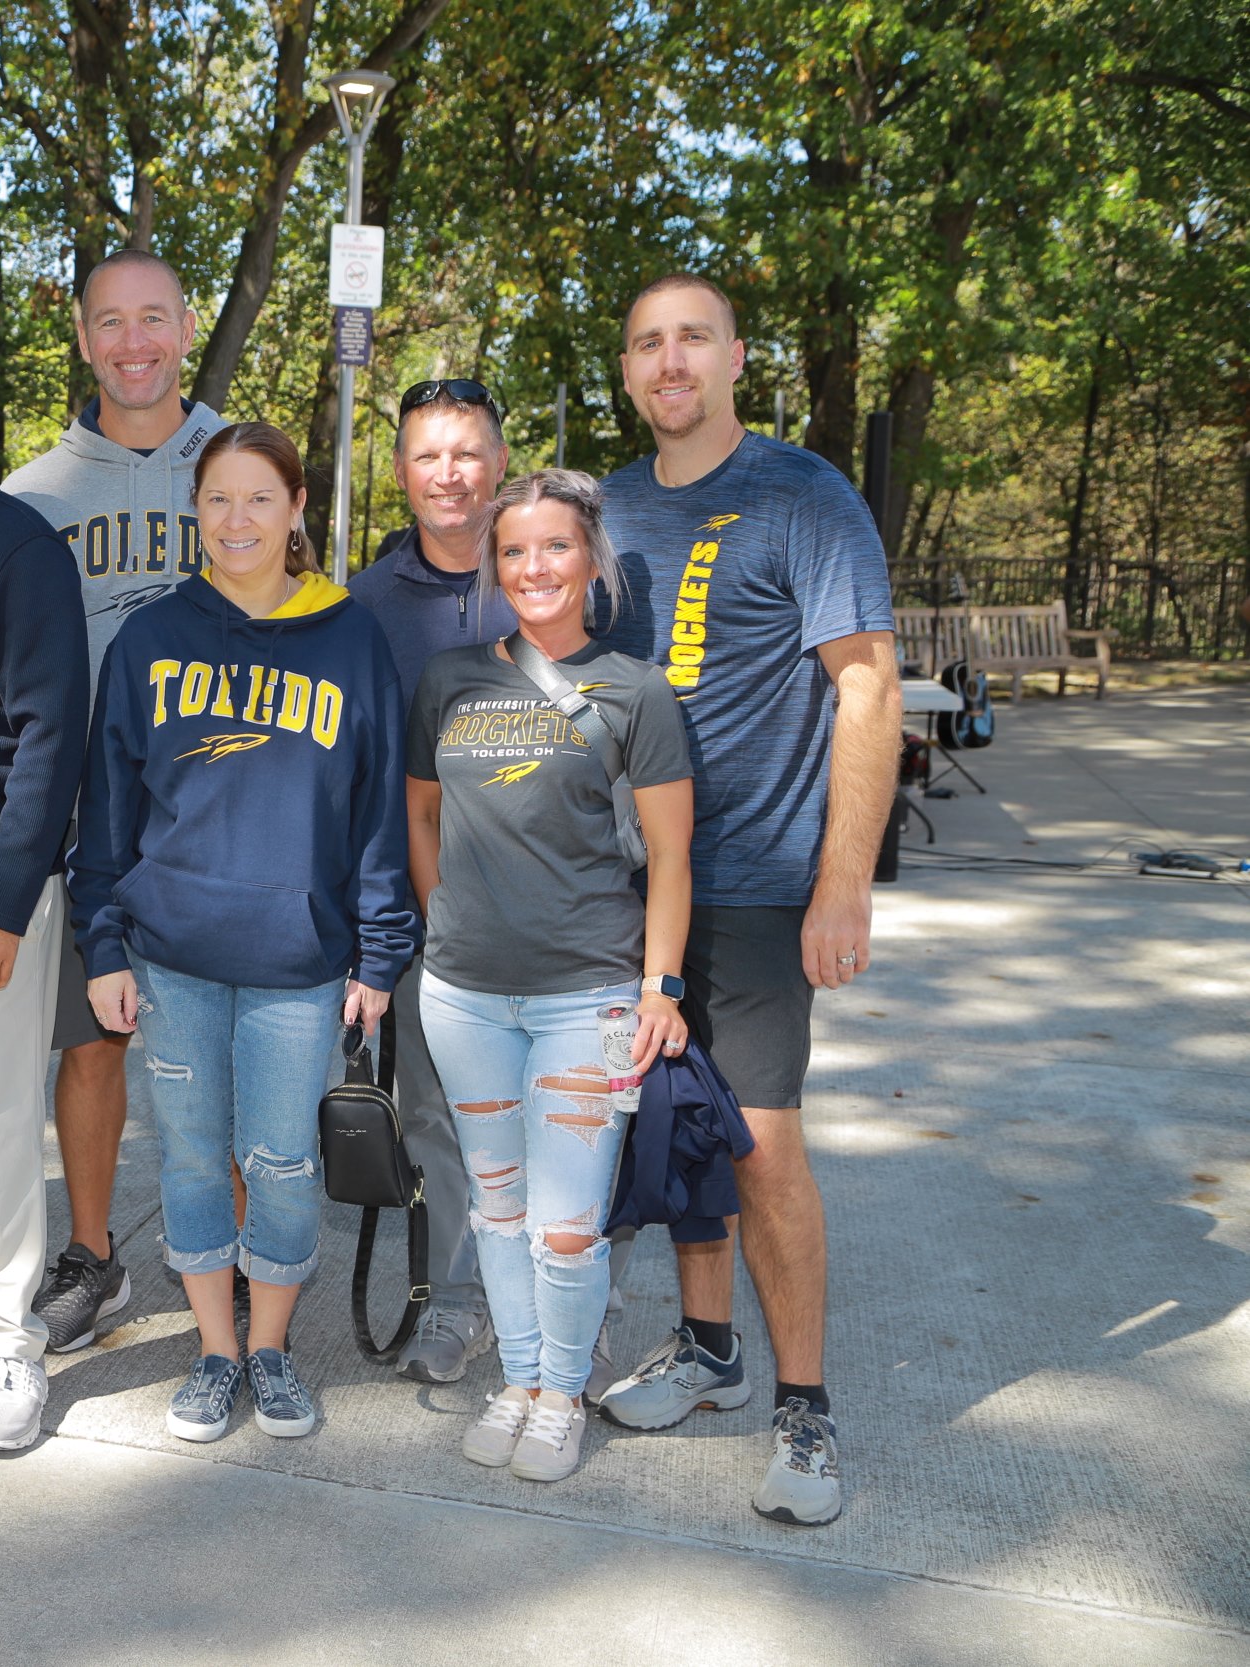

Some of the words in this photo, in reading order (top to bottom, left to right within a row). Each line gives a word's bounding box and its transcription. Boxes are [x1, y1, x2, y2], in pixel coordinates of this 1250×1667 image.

[179, 426, 208, 459] ROCKETS
[664, 541, 719, 687] ROCKETS
[149, 658, 344, 750] TOLEDO
[457, 702, 472, 715] THE
[474, 699, 537, 711] UNIVERSITY
[470, 747, 529, 758] TOLEDO,
[533, 747, 554, 756] OH
